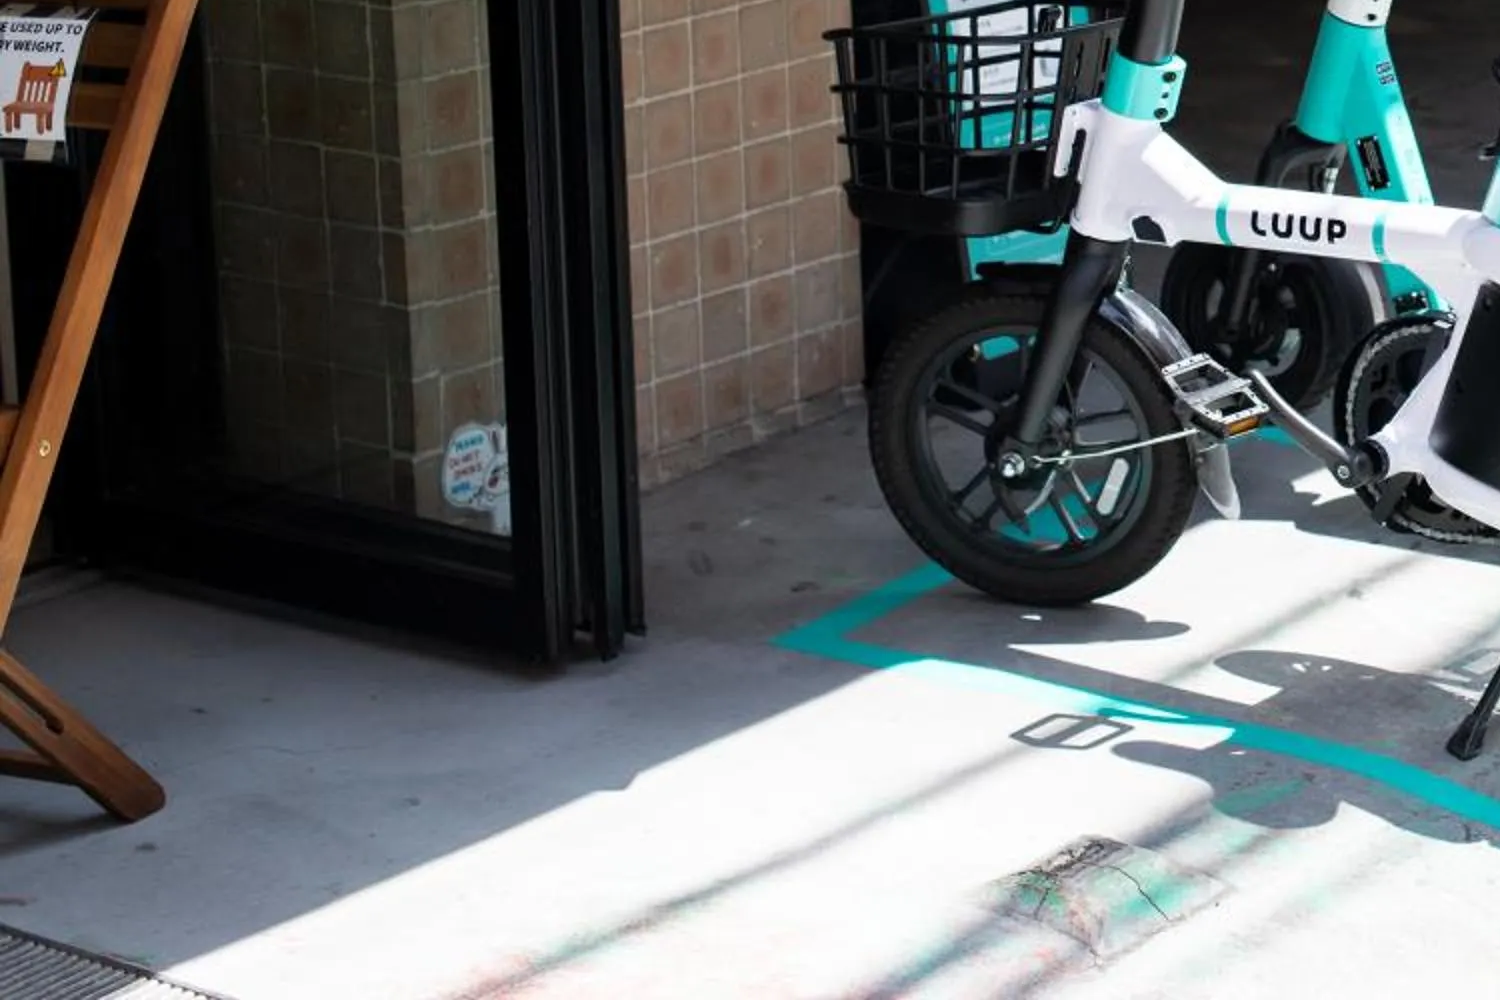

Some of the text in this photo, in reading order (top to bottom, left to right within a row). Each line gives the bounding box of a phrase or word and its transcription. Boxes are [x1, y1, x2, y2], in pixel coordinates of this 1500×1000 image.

[10, 22, 43, 34] USED
[46, 23, 64, 35] UP
[66, 23, 83, 35] TO
[1250, 210, 1347, 244] LUUP
